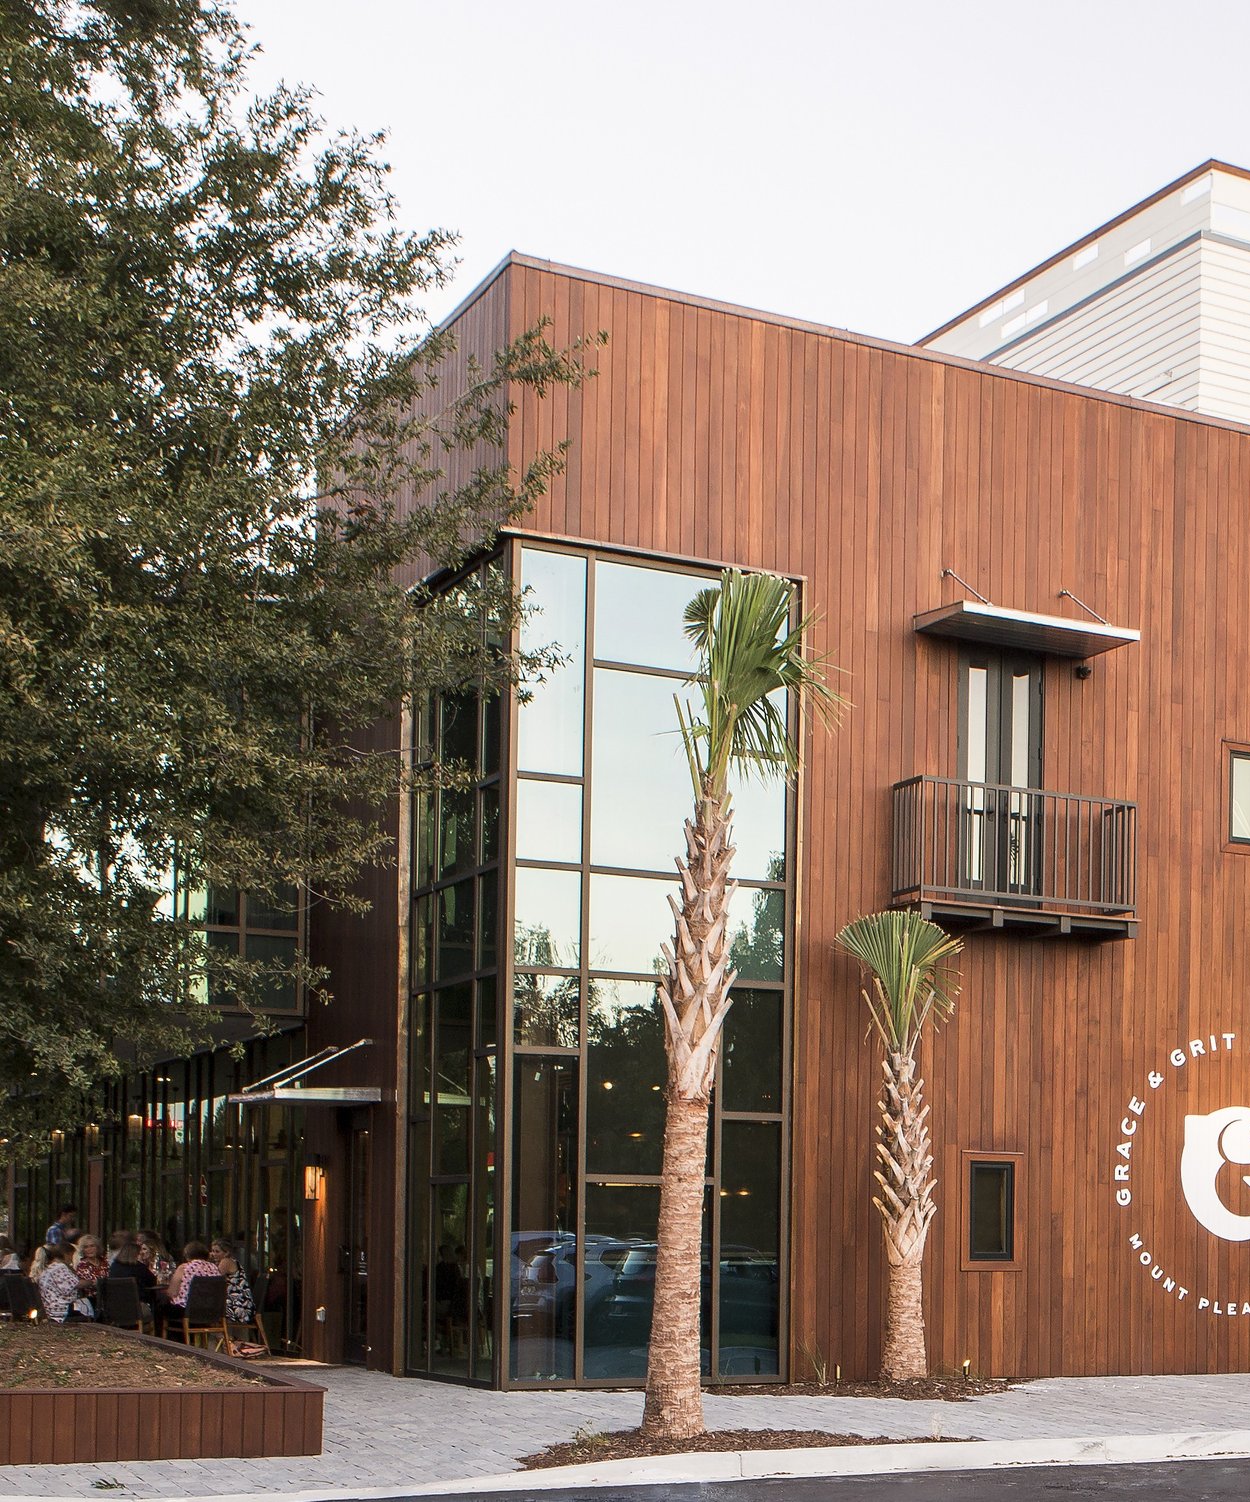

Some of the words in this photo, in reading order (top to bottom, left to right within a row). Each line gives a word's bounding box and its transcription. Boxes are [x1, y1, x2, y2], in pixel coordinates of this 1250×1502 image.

[1114, 1095, 1146, 1207] GRACE
[1147, 1070, 1165, 1089] &
[1169, 1033, 1236, 1067] GRIT
[1128, 1232, 1189, 1301] MOUNT
